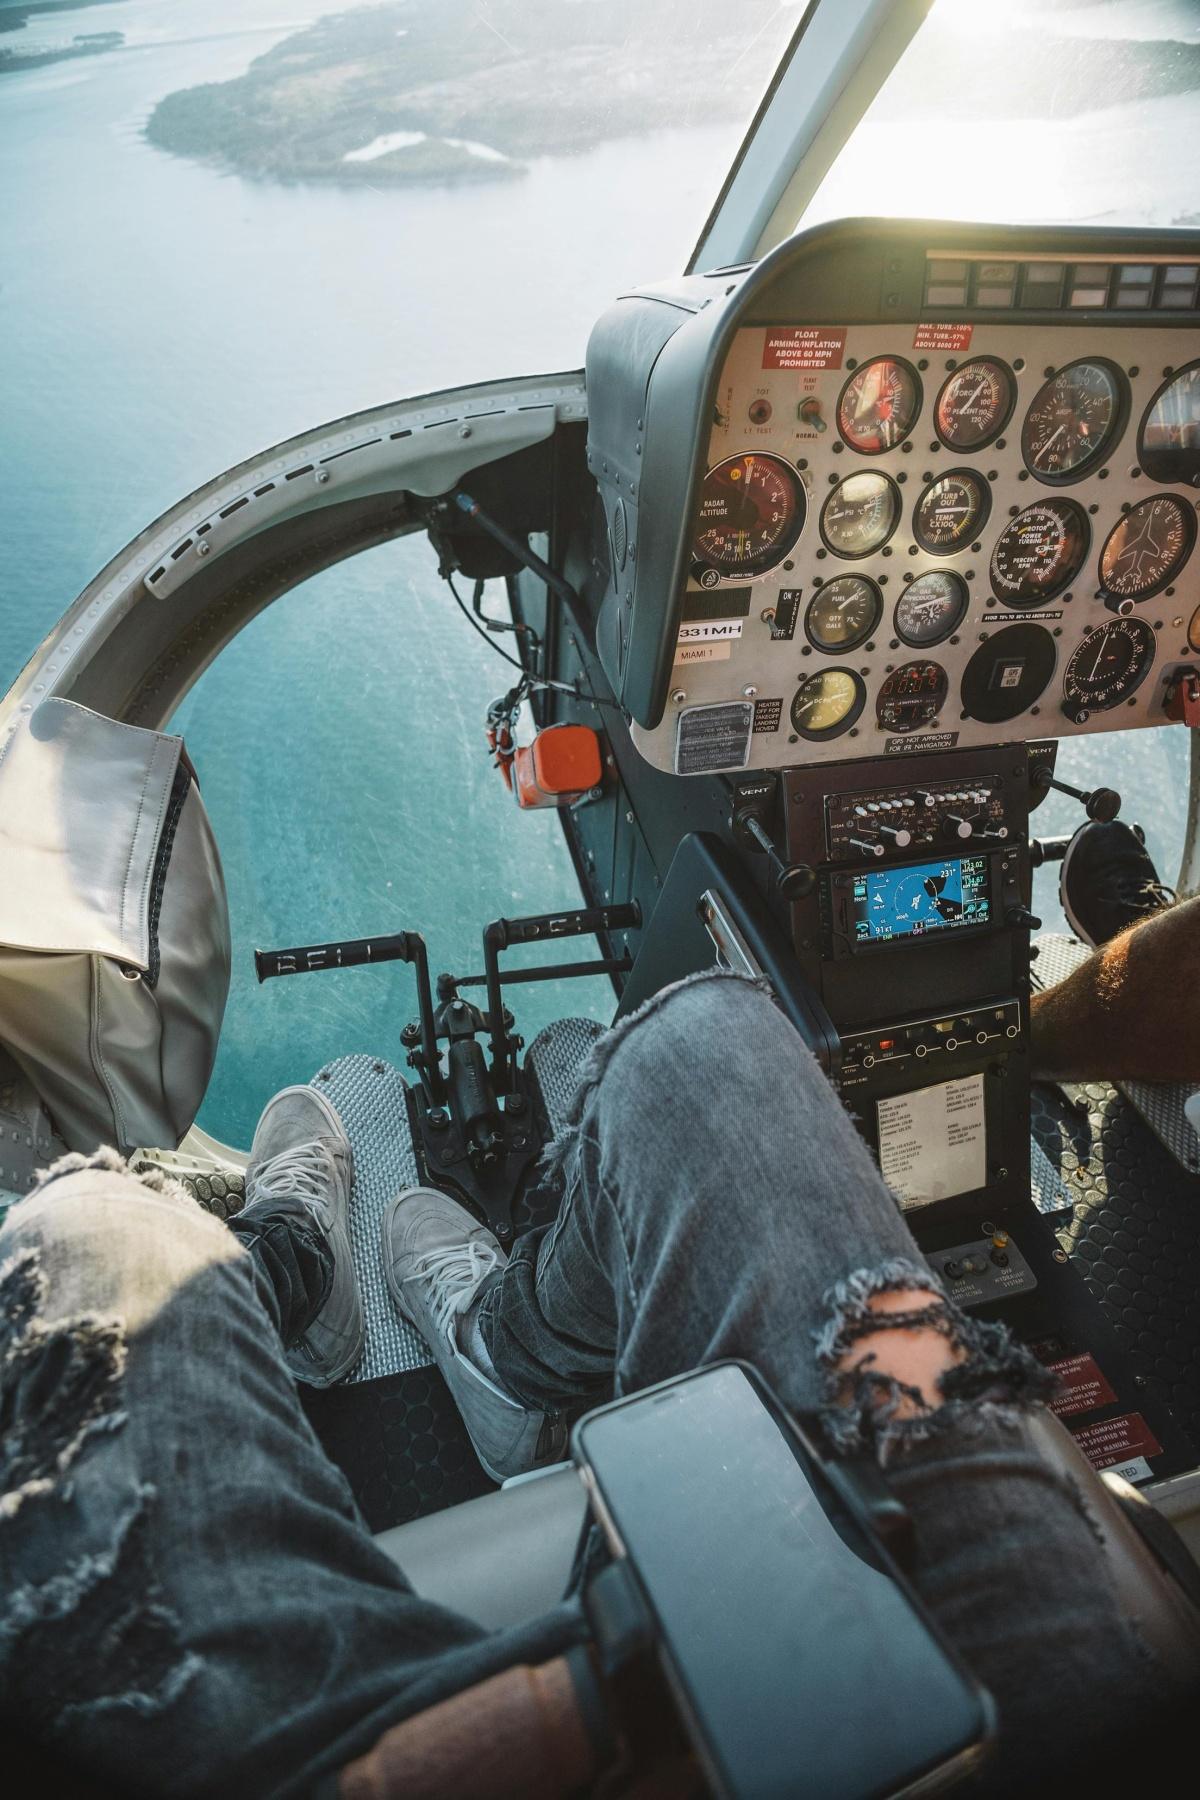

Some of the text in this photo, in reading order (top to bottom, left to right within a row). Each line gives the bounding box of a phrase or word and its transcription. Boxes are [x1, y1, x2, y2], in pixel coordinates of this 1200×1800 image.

[769, 340, 842, 348] ARMING/INFLATION
[761, 478, 766, 487] 1
[771, 492, 777, 502] 2
[700, 508, 728, 516] ALTITUDE
[1139, 507, 1144, 516] 3
[772, 512, 778, 521] 3
[707, 530, 716, 538] 25
[762, 530, 768, 540] 4
[724, 543, 732, 551] 15
[745, 541, 751, 550] 5
[783, 592, 792, 600] ON
[680, 626, 742, 637] 331MH
[681, 650, 706, 659] MIAMI
[922, 734, 952, 742] APPROVED
[914, 741, 951, 750] NAVIGATION
[740, 787, 769, 796] VENT
[1091, 1420, 1129, 1435] COMPLIANCE
[1089, 1433, 1118, 1445] SPECIFIED
[1103, 1440, 1130, 1451] MANUAL
[1105, 1457, 1116, 1465] LBS
